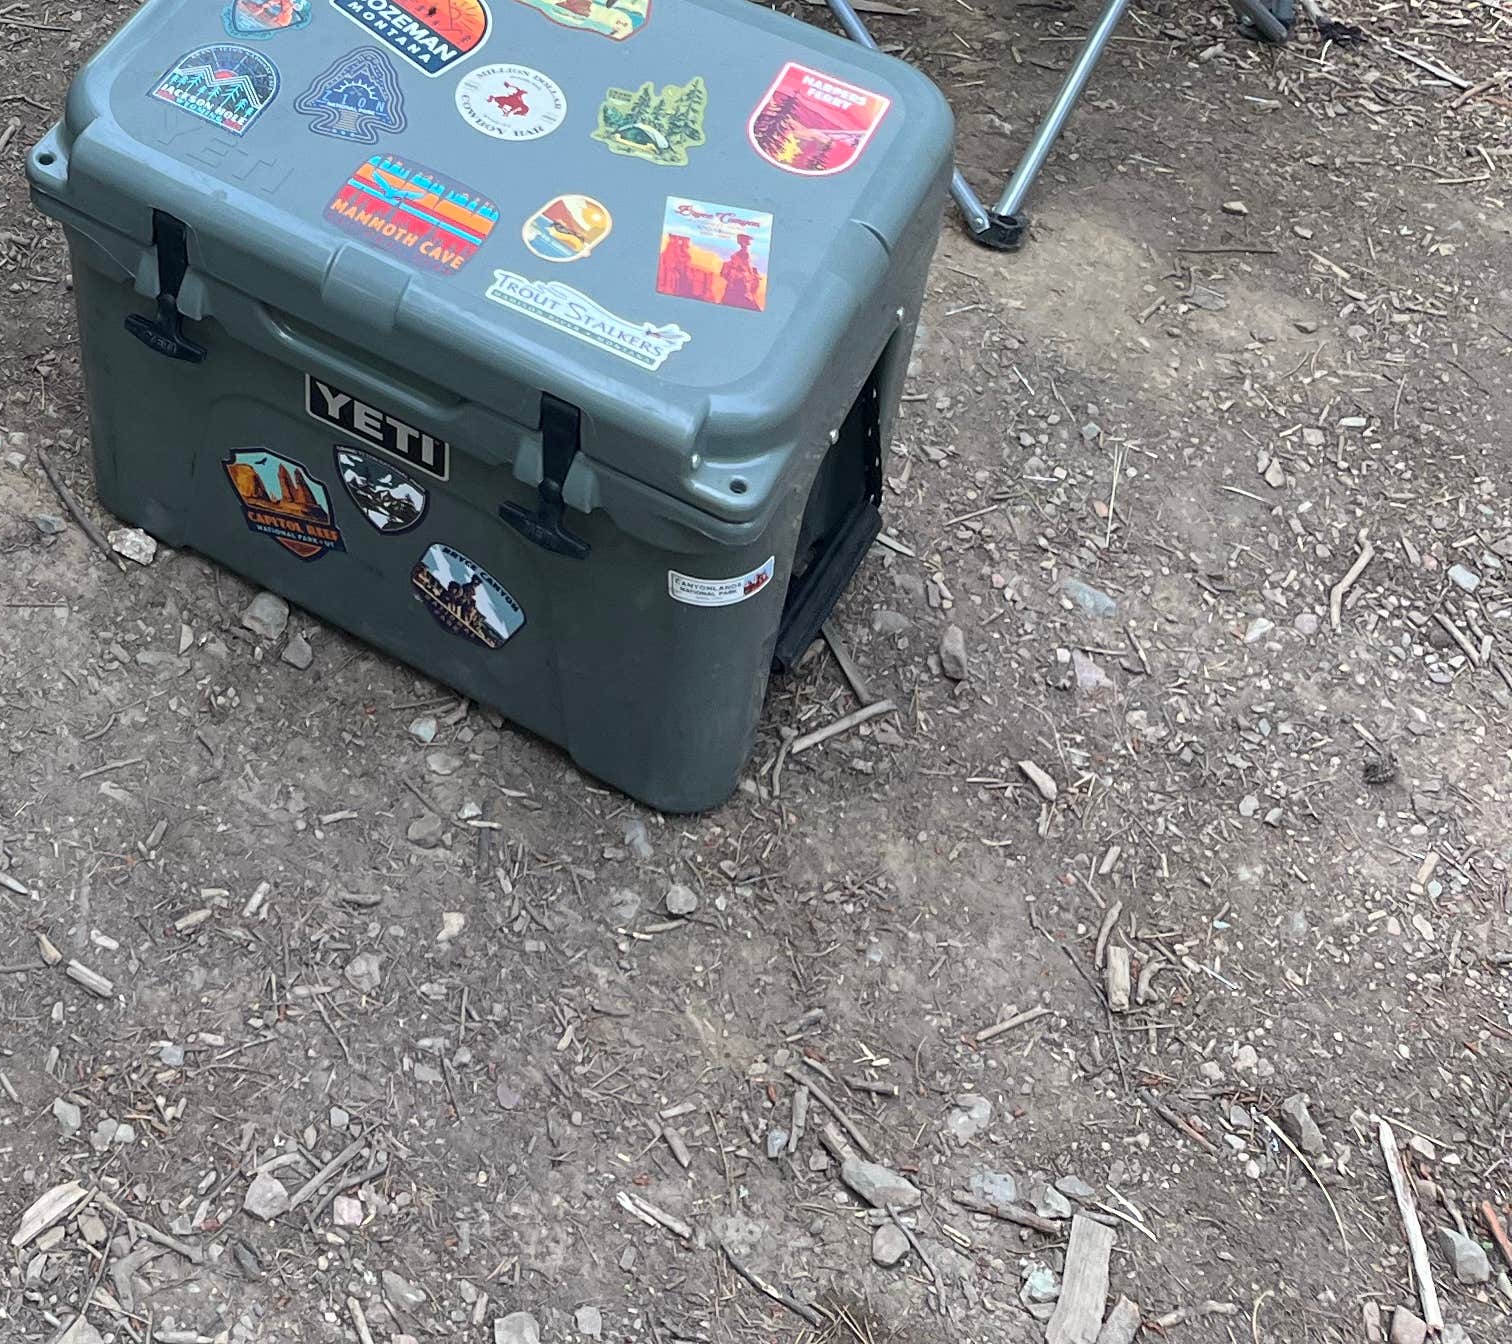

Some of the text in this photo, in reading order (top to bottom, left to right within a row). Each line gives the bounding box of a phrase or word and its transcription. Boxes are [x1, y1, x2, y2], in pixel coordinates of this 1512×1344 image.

[347, 1, 432, 63] MONTANA
[161, 83, 248, 126] JACKSON HOLE
[321, 89, 385, 112] ZION
[476, 68, 530, 79] MILLION
[533, 75, 562, 110] DOLLAR
[801, 75, 867, 106] HARPERS
[806, 87, 852, 110] FERRY
[462, 94, 504, 135] COWBOY
[330, 198, 465, 270] MAMMOTH CAVE
[498, 273, 664, 357] TROUT STALKERS
[315, 381, 434, 466] YETI
[248, 512, 338, 542] CAPITOL REEF
[256, 524, 296, 538] NATIONAL
[297, 533, 319, 545] PARK
[442, 547, 519, 612] BRYCE CANYON
